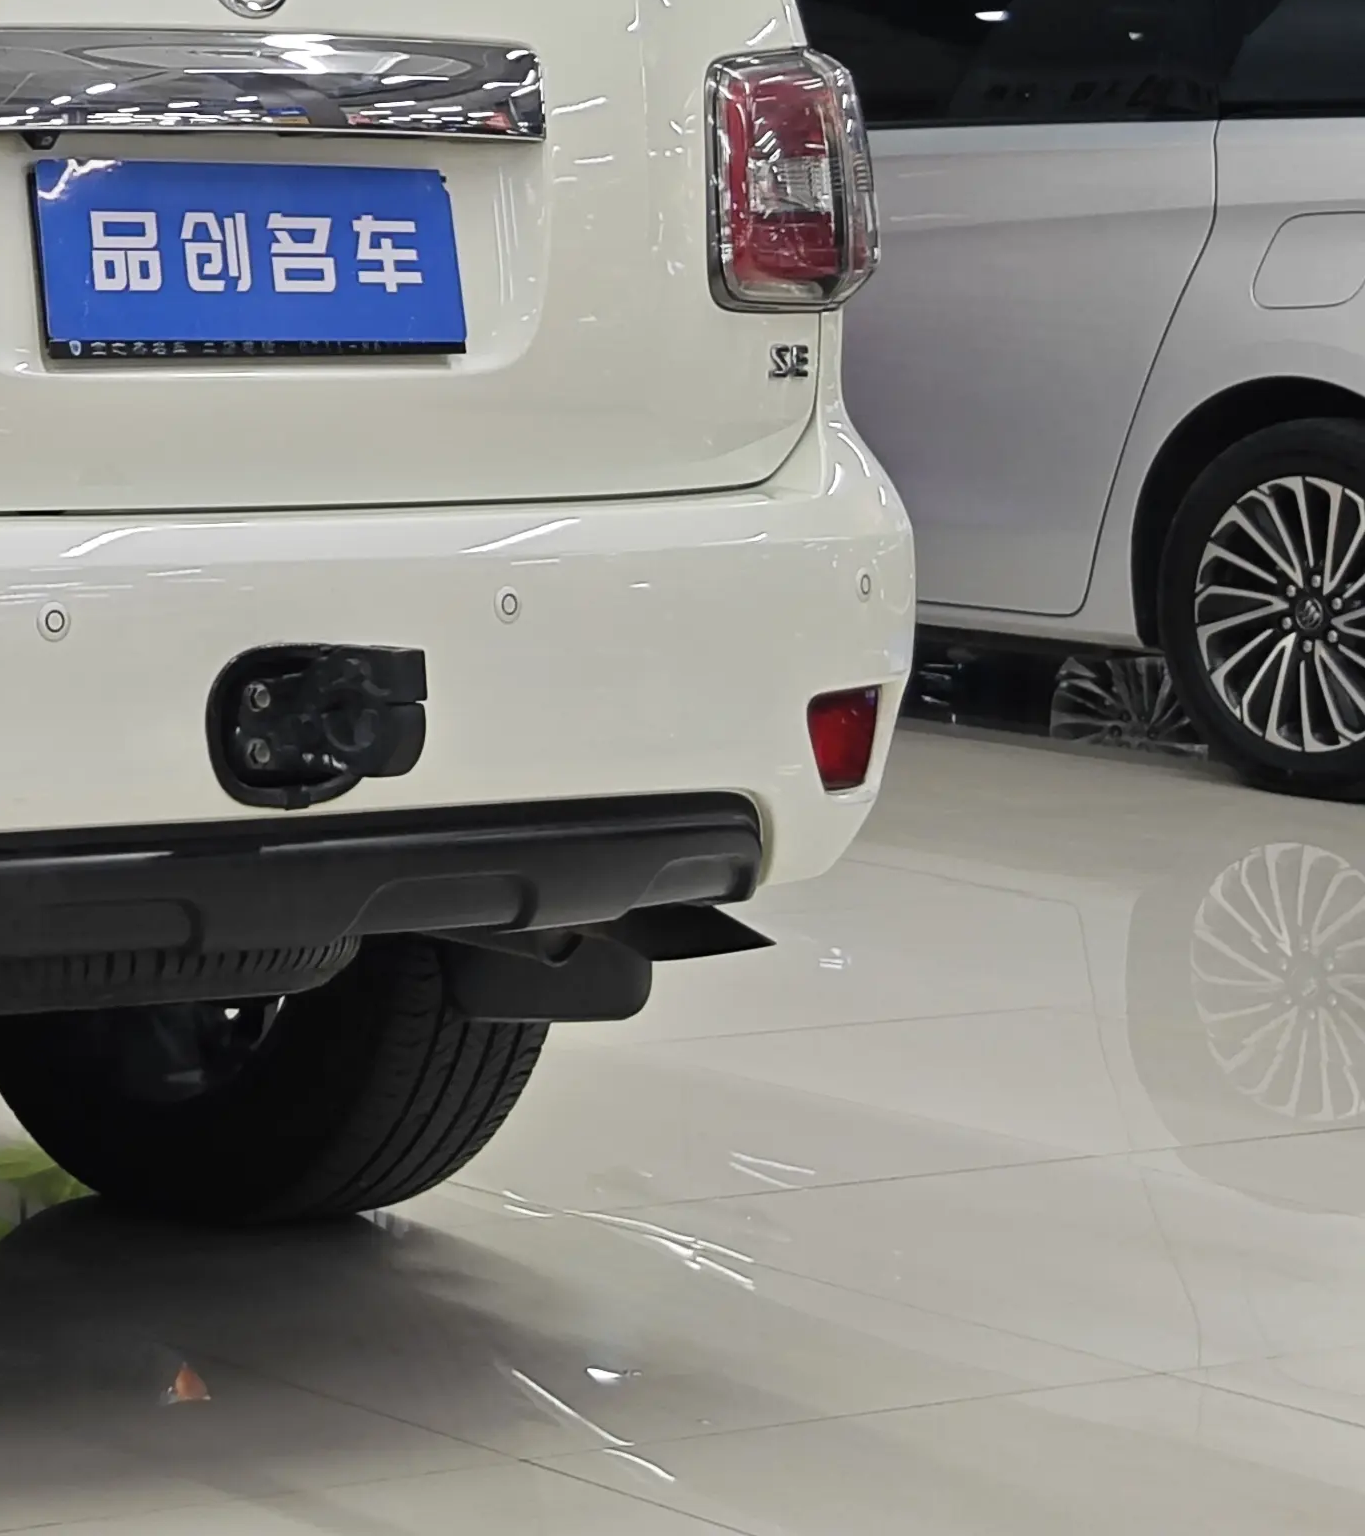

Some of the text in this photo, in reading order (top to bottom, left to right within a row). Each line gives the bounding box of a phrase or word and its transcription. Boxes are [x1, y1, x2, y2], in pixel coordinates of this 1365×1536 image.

[89, 210, 424, 293] 品创名车
[768, 343, 810, 379] SE
